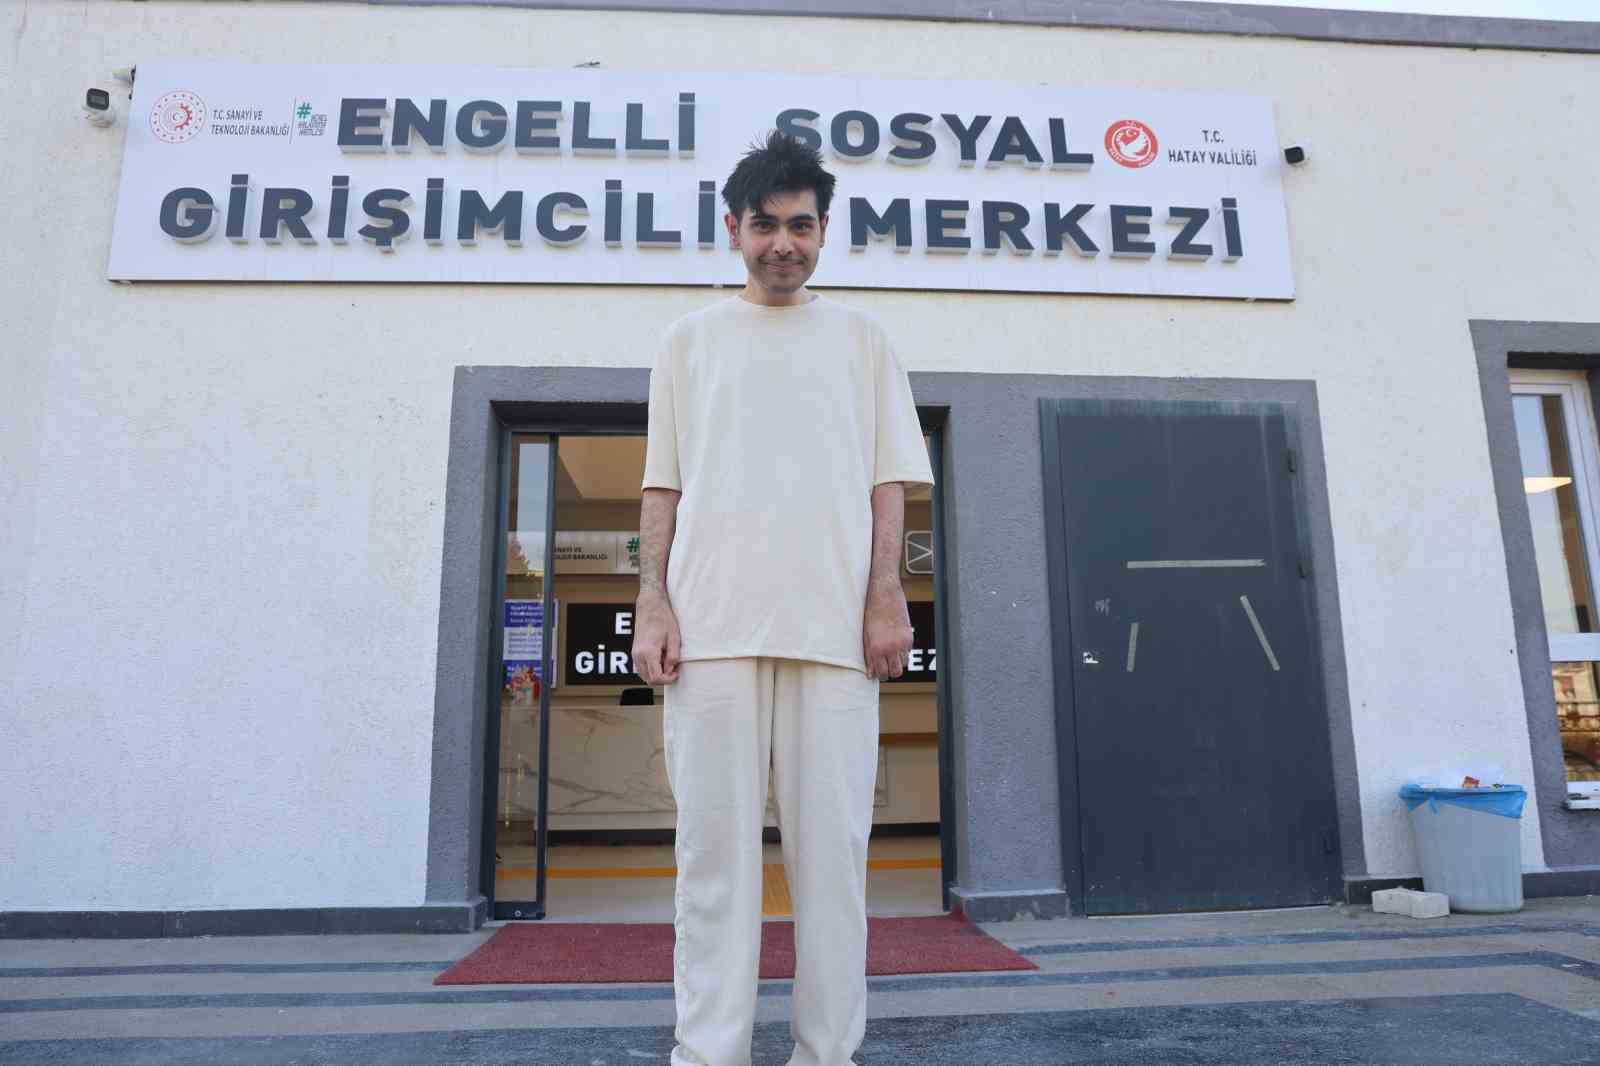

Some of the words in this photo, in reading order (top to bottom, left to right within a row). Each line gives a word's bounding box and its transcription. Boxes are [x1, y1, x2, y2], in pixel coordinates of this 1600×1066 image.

[226, 109, 253, 121] SANAYİ
[253, 110, 263, 121] VE
[211, 124, 250, 136] TEKNOLOJİ
[250, 125, 290, 136] BAKANLIĞI
[336, 92, 696, 156] ENGELLİ
[775, 108, 1095, 168] SOSYAL
[1202, 130, 1224, 143] T.C.
[1168, 149, 1206, 164] HATAY
[1208, 150, 1257, 166] VALİLİĞİ
[159, 174, 717, 249] GİRİŞİMCİLİ
[848, 196, 1244, 260] MERKEZİ
[575, 644, 630, 675] GİR
